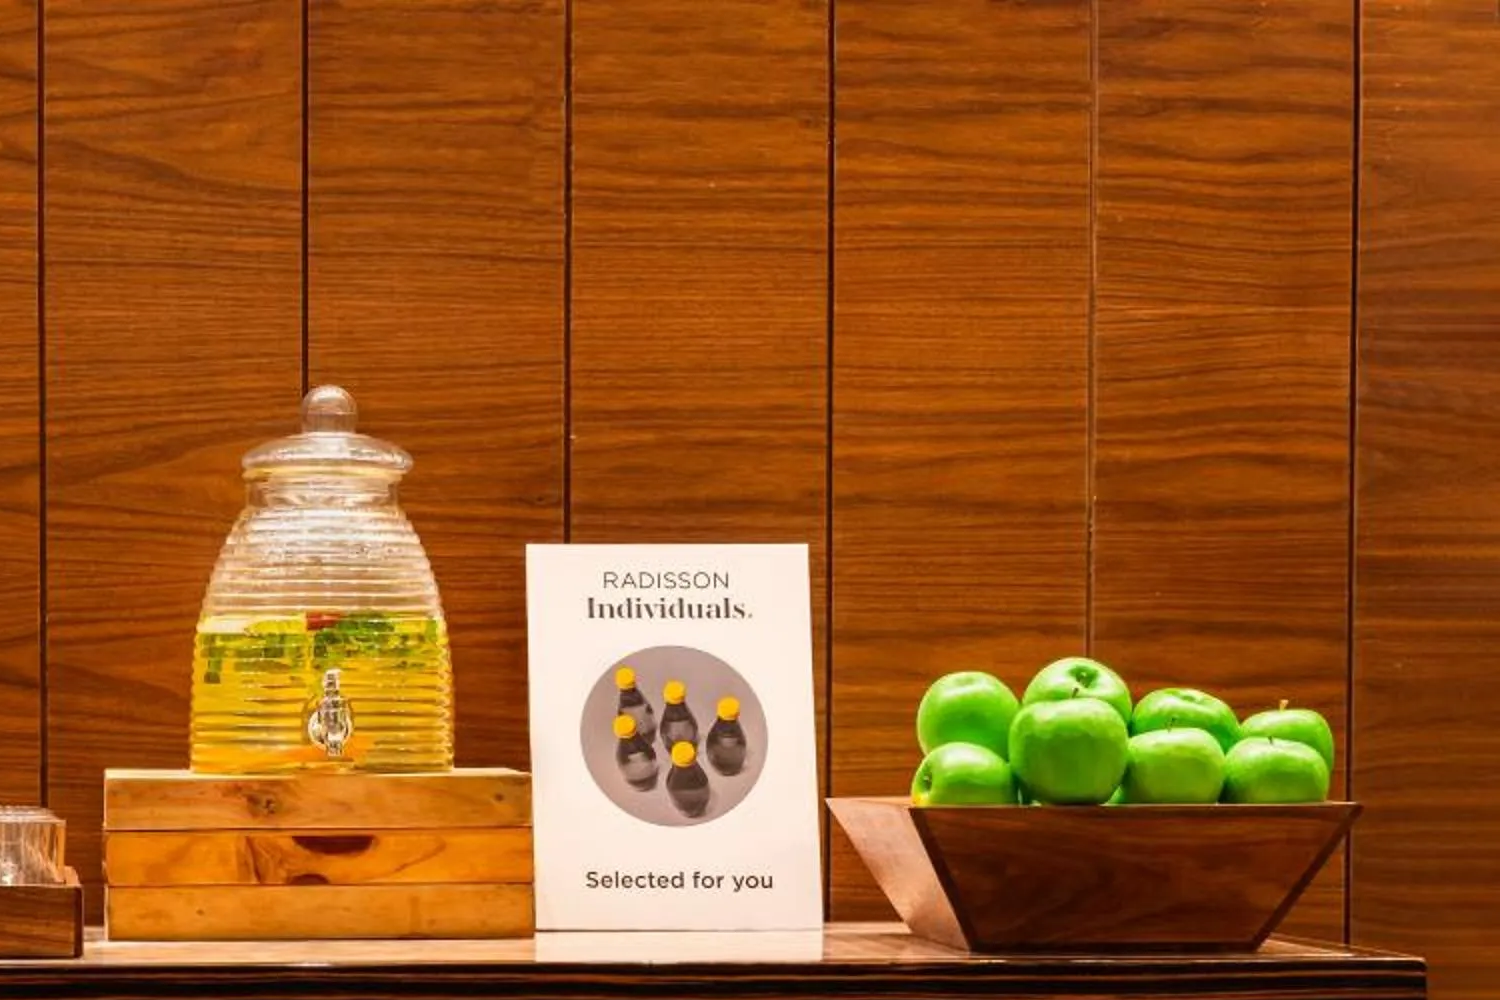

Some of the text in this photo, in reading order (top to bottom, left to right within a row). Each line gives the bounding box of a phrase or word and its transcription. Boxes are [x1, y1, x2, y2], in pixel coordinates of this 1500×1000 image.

[603, 571, 730, 589] RADISSON
[587, 597, 753, 619] Individuals.
[585, 871, 774, 893] Selected for you
